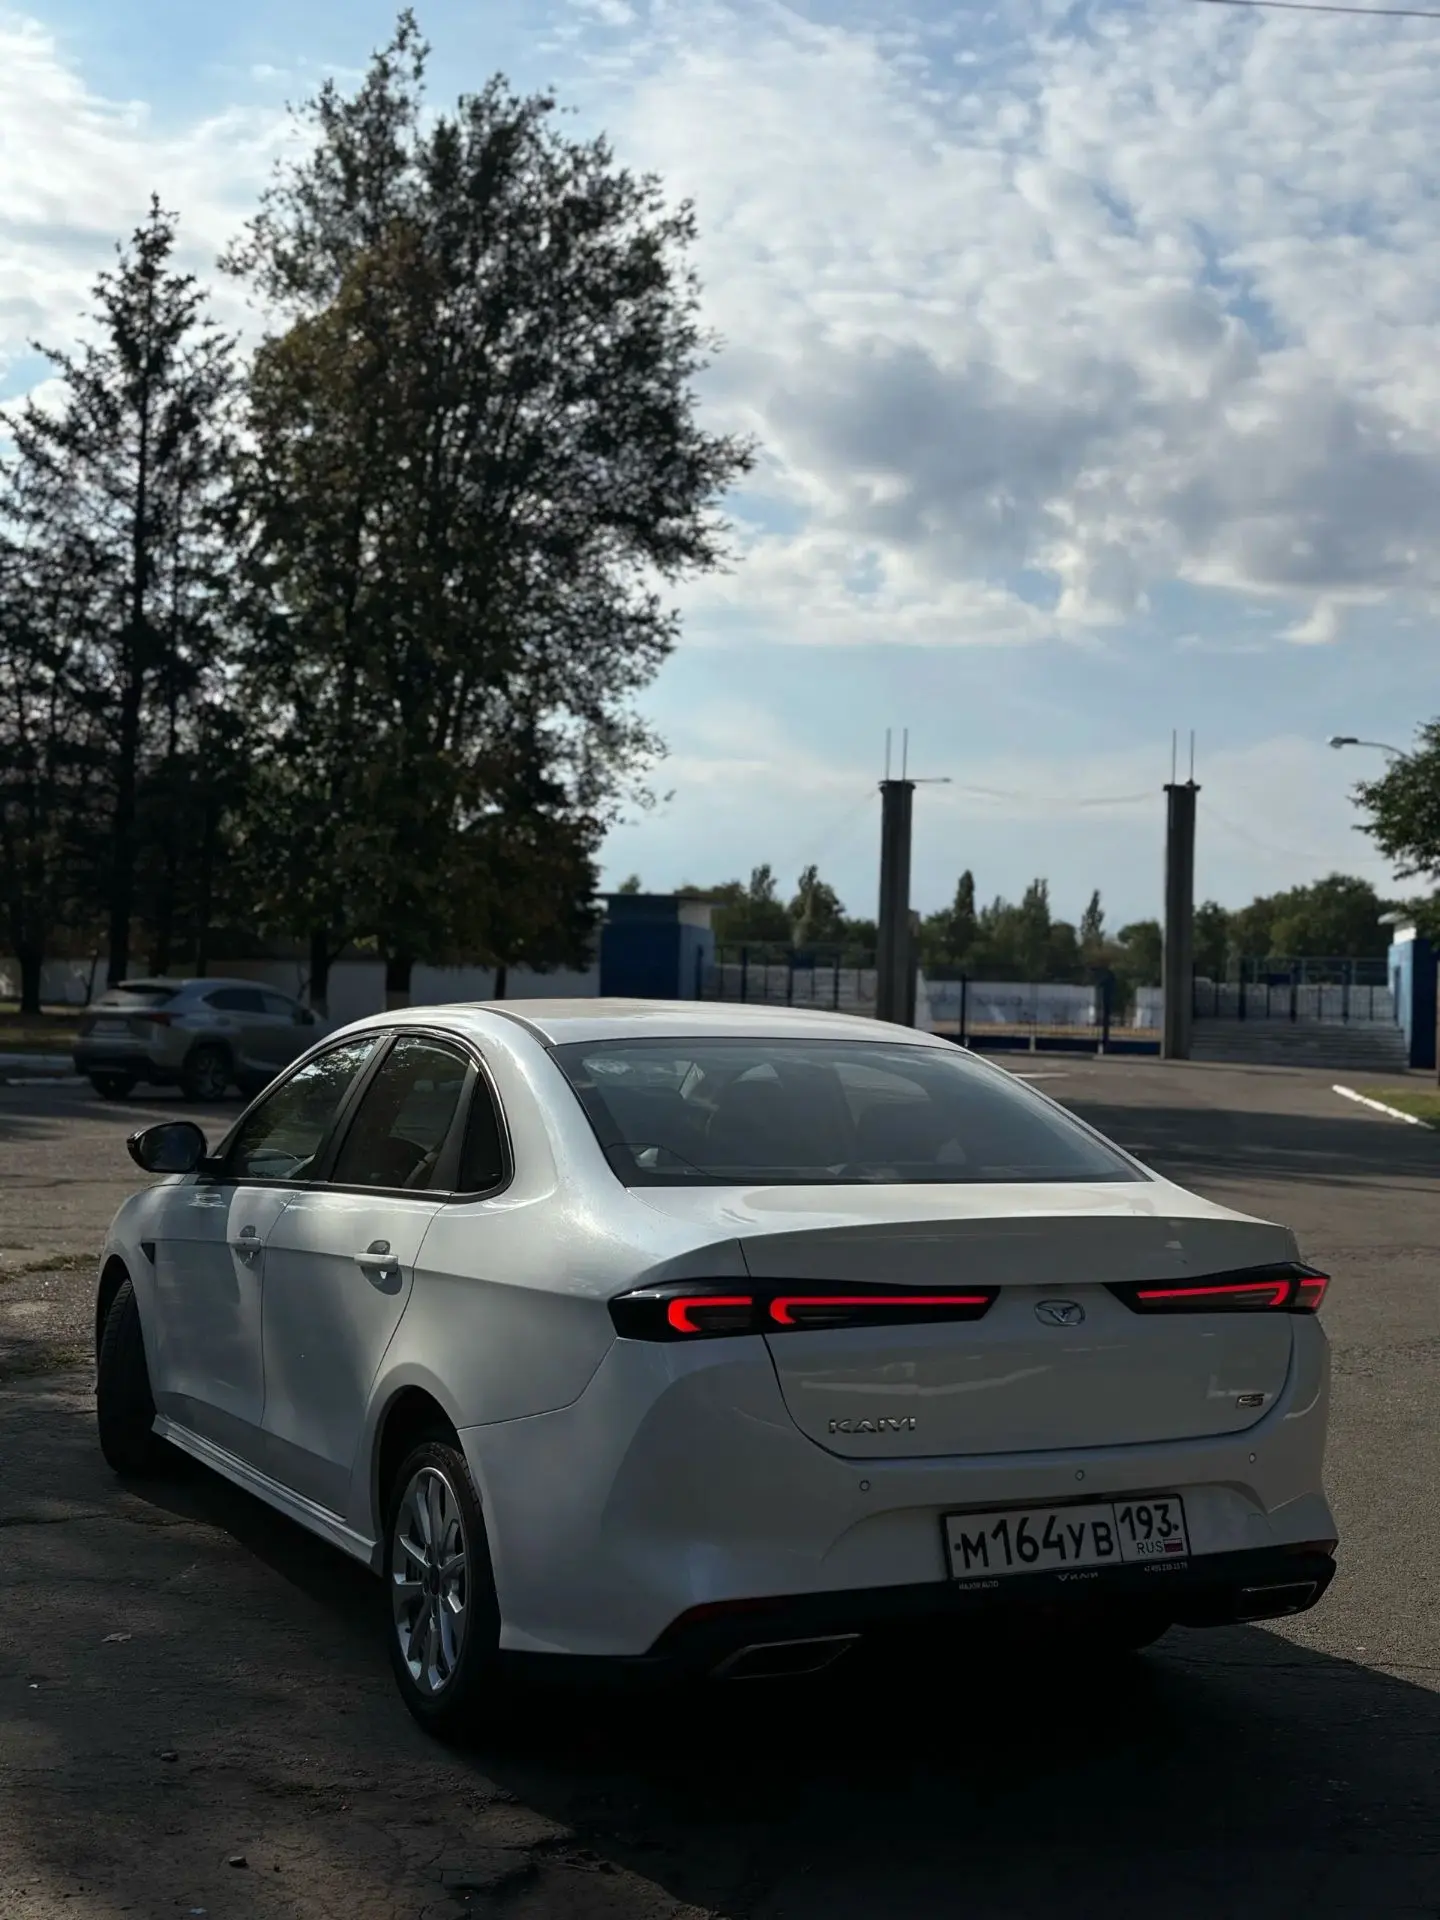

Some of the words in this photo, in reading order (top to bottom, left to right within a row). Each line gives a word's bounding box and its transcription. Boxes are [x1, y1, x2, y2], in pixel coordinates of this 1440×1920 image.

[961, 1515, 1114, 1569] М164УВ
[1120, 1504, 1172, 1540] 193
[1136, 1540, 1164, 1555] RUS
